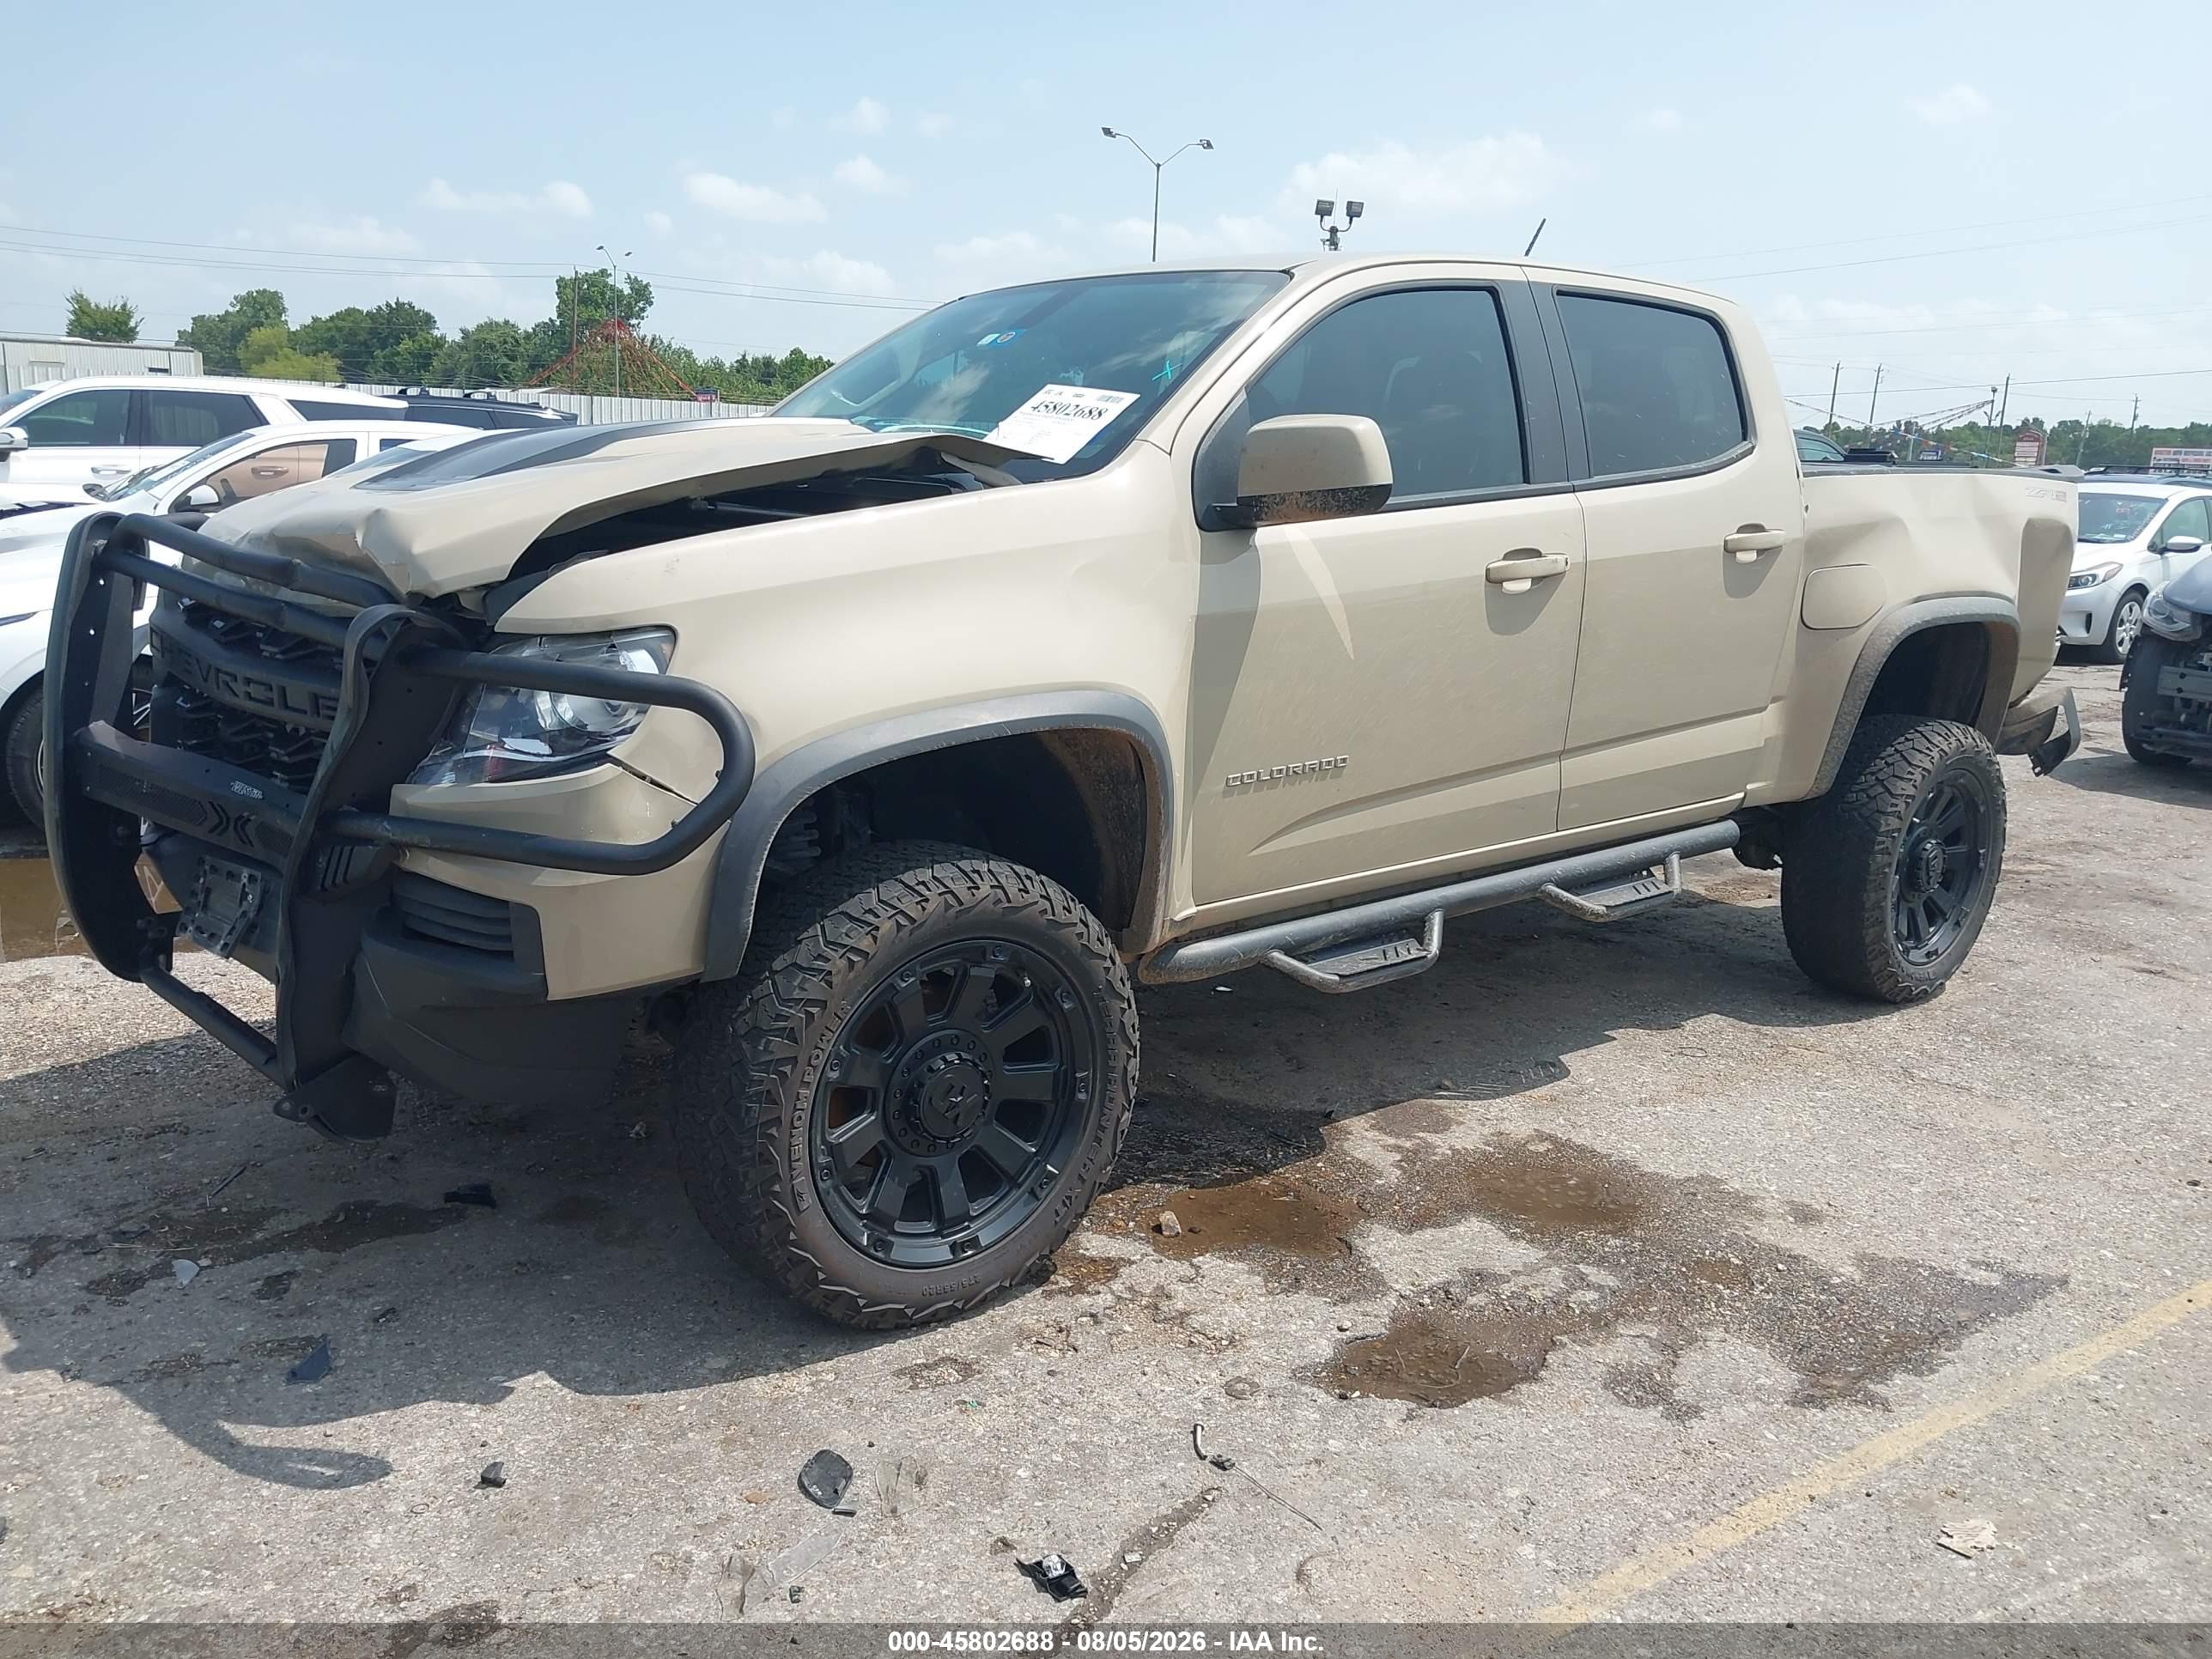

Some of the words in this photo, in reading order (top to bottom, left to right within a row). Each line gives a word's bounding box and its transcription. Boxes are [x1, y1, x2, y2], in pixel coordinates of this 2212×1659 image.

[1030, 399, 1109, 420] 45802688
[1226, 755, 1350, 787] COLORADO
[789, 1089, 811, 1182] VENOM
